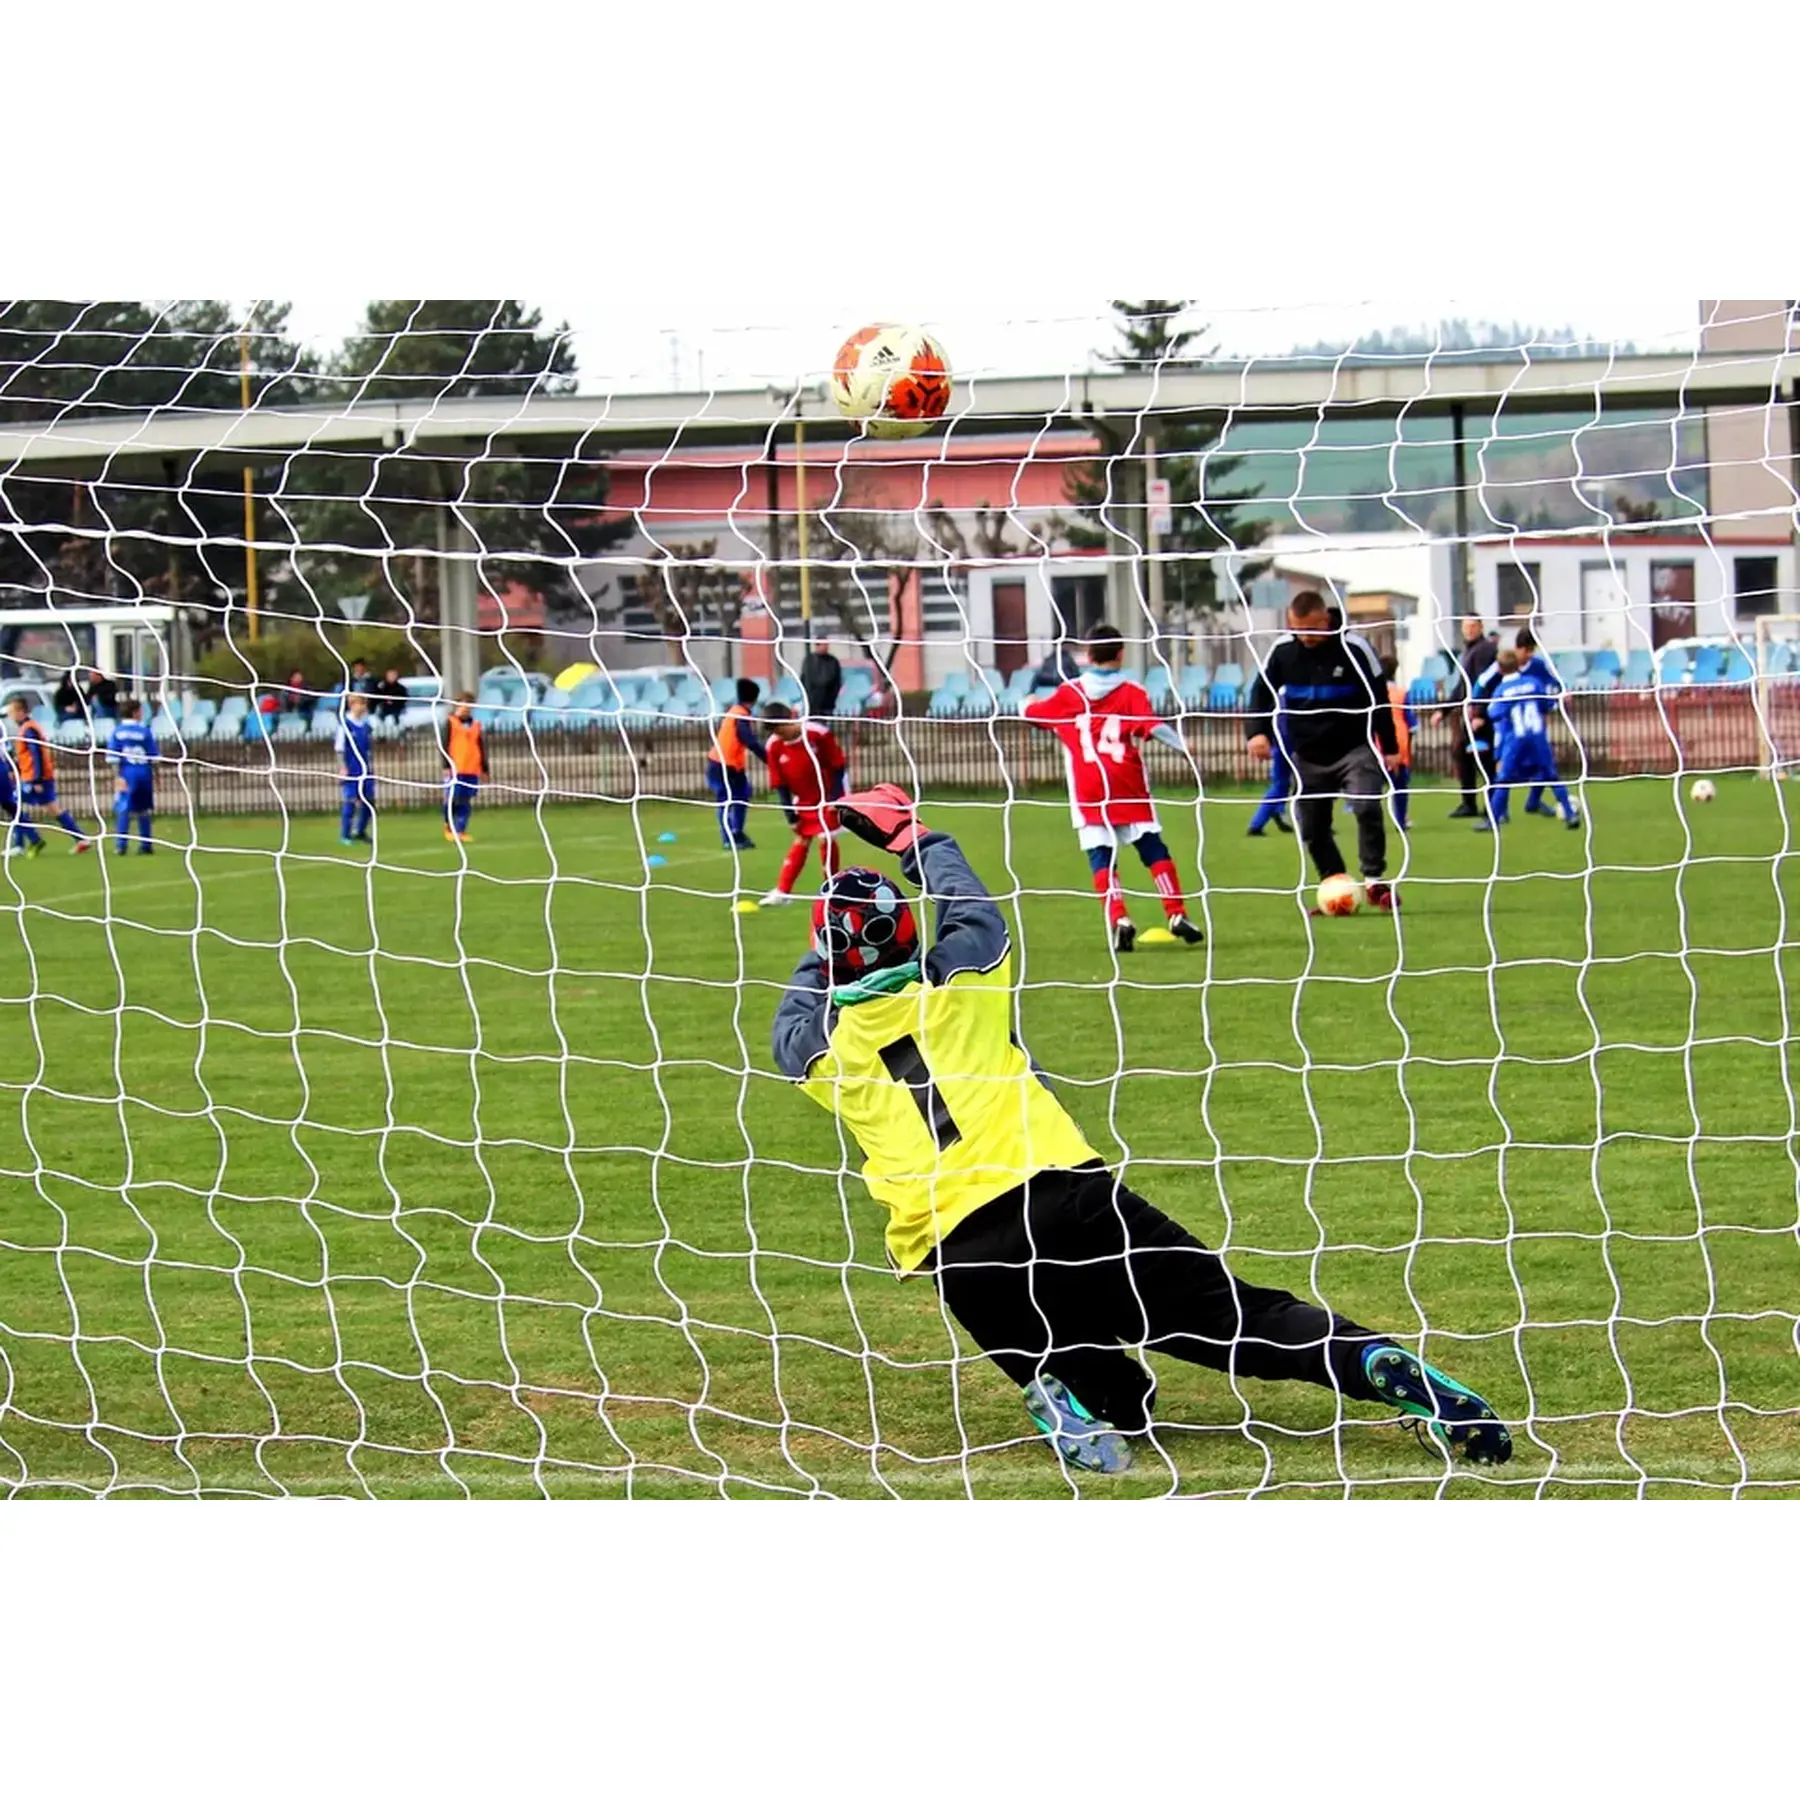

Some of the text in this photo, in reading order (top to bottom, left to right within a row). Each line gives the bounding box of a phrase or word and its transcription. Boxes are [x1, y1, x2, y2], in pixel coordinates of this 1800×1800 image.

[1075, 714, 1125, 763] 14
[1511, 701, 1543, 737] 14
[877, 1033, 963, 1152] 1
